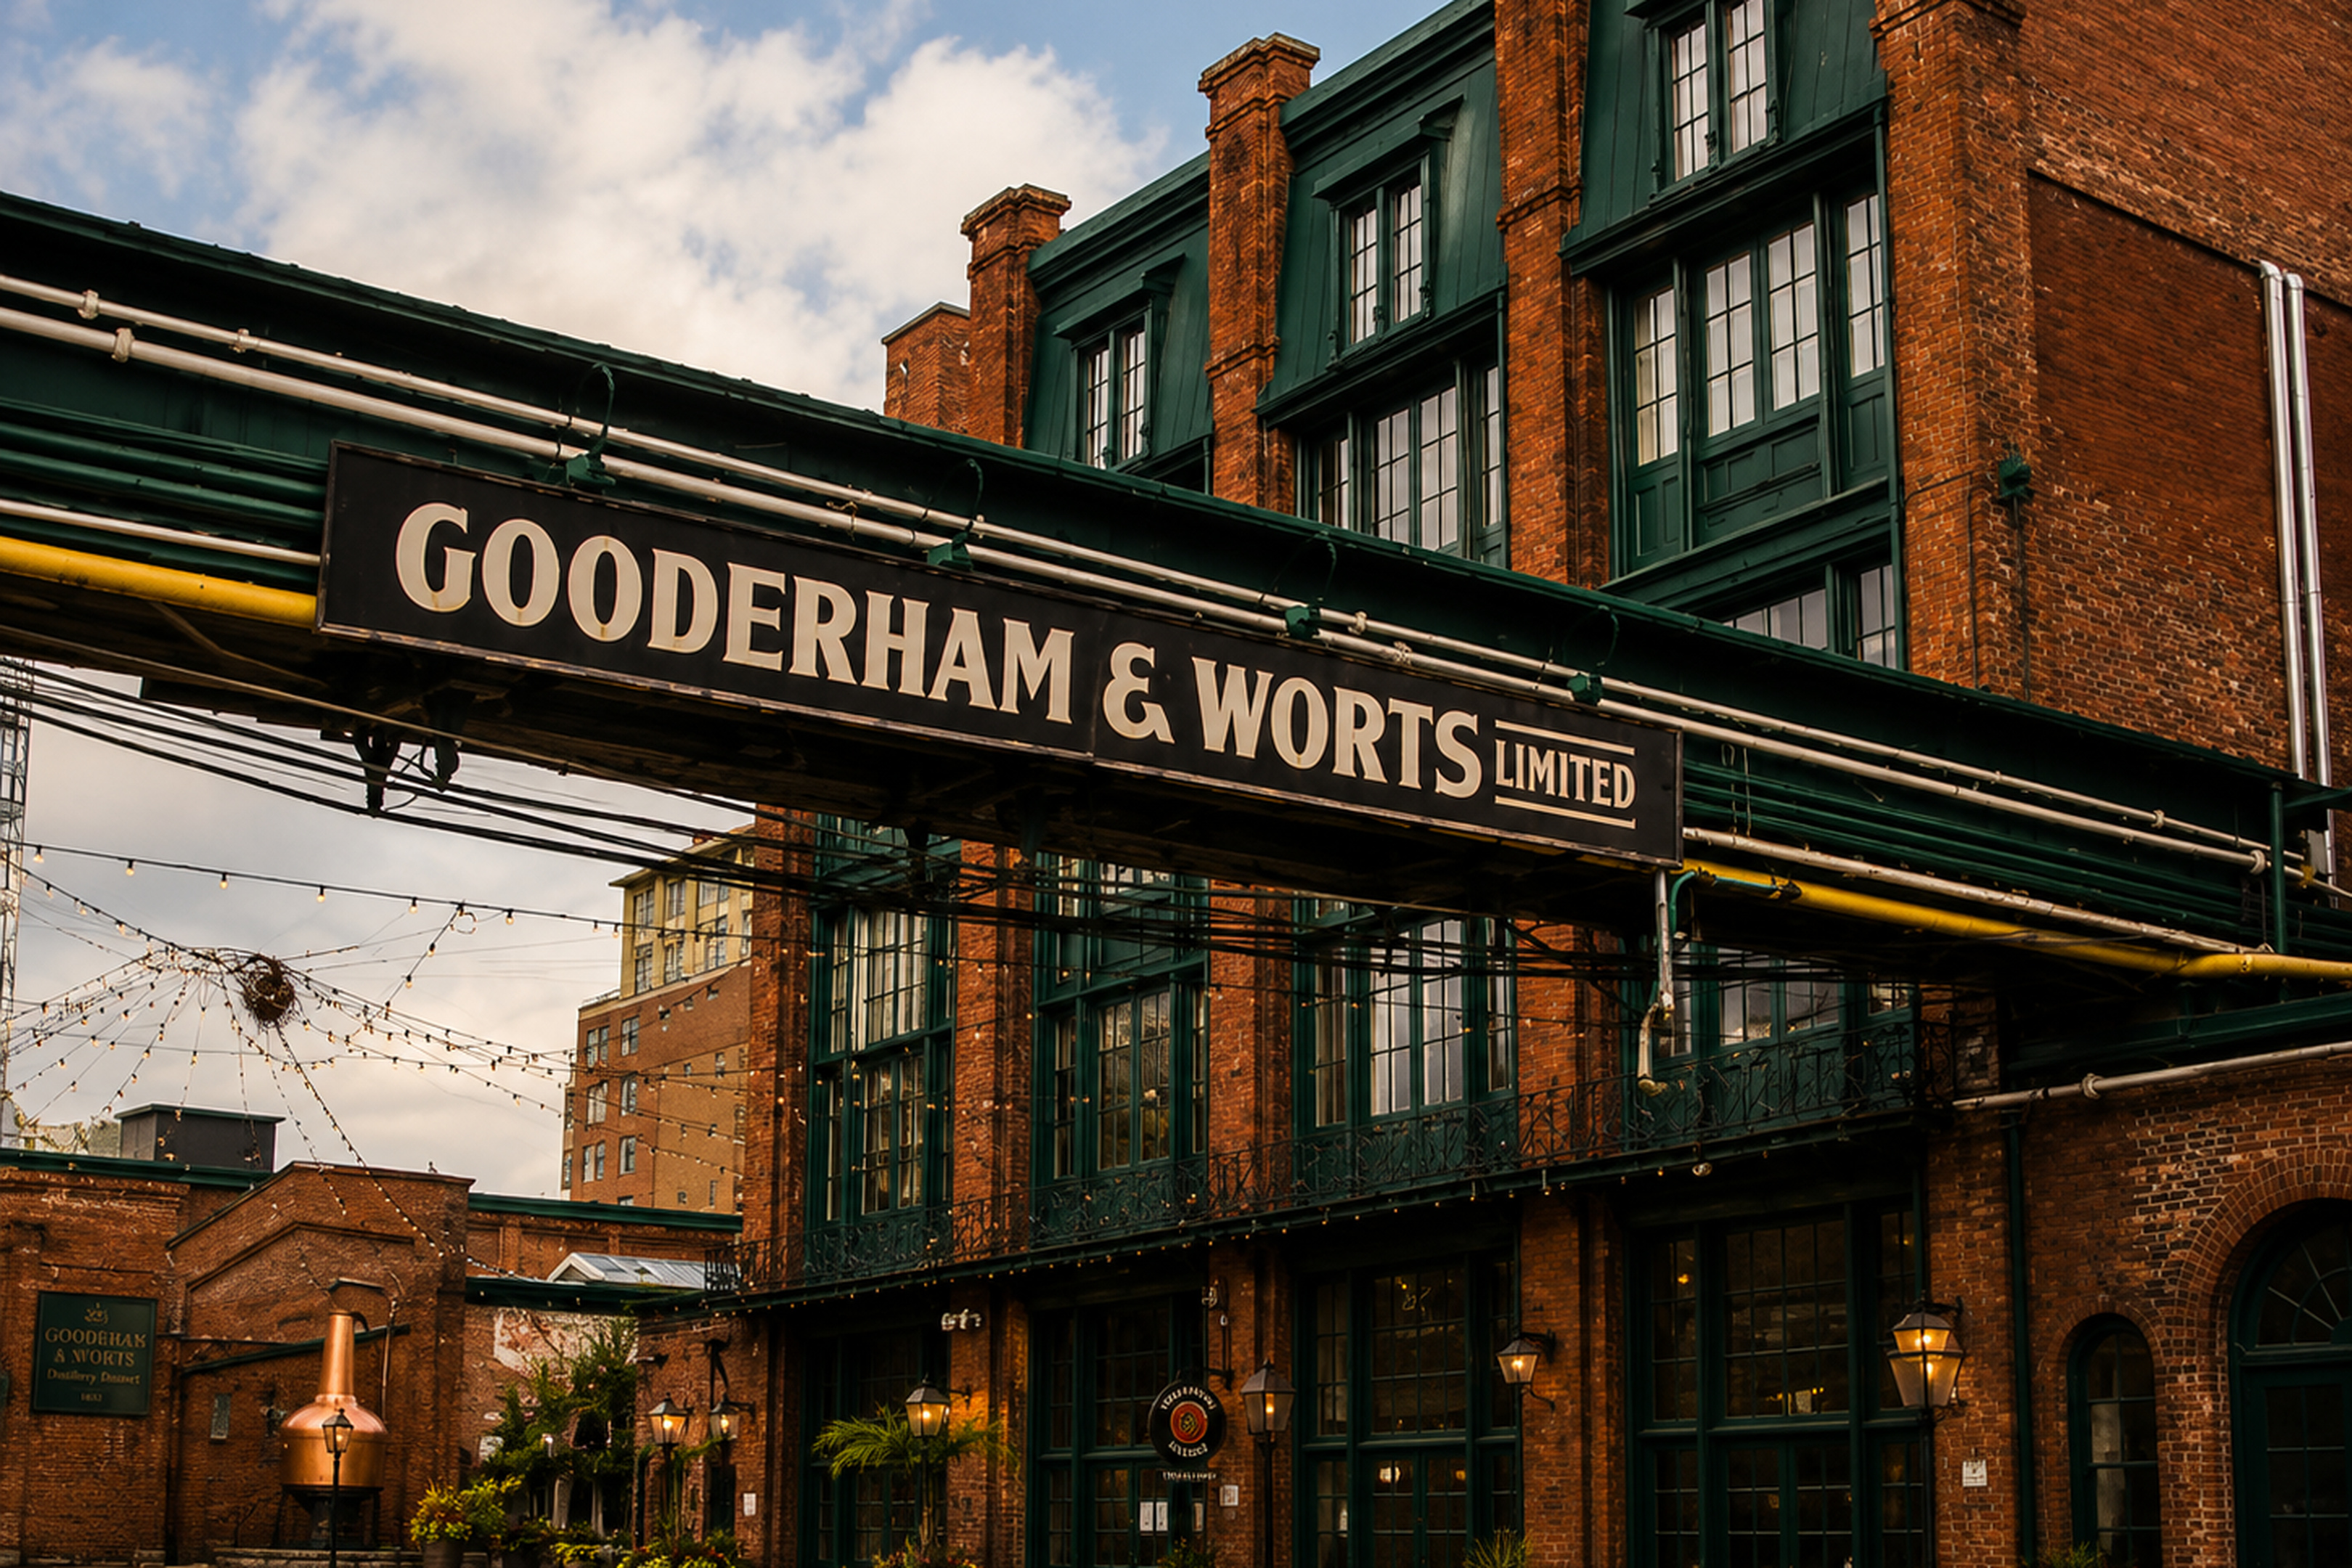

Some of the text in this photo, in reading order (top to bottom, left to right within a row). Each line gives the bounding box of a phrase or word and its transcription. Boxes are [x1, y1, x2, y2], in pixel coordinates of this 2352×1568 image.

[396, 502, 1637, 810] GOODERHAM & WORTS LIMITED
